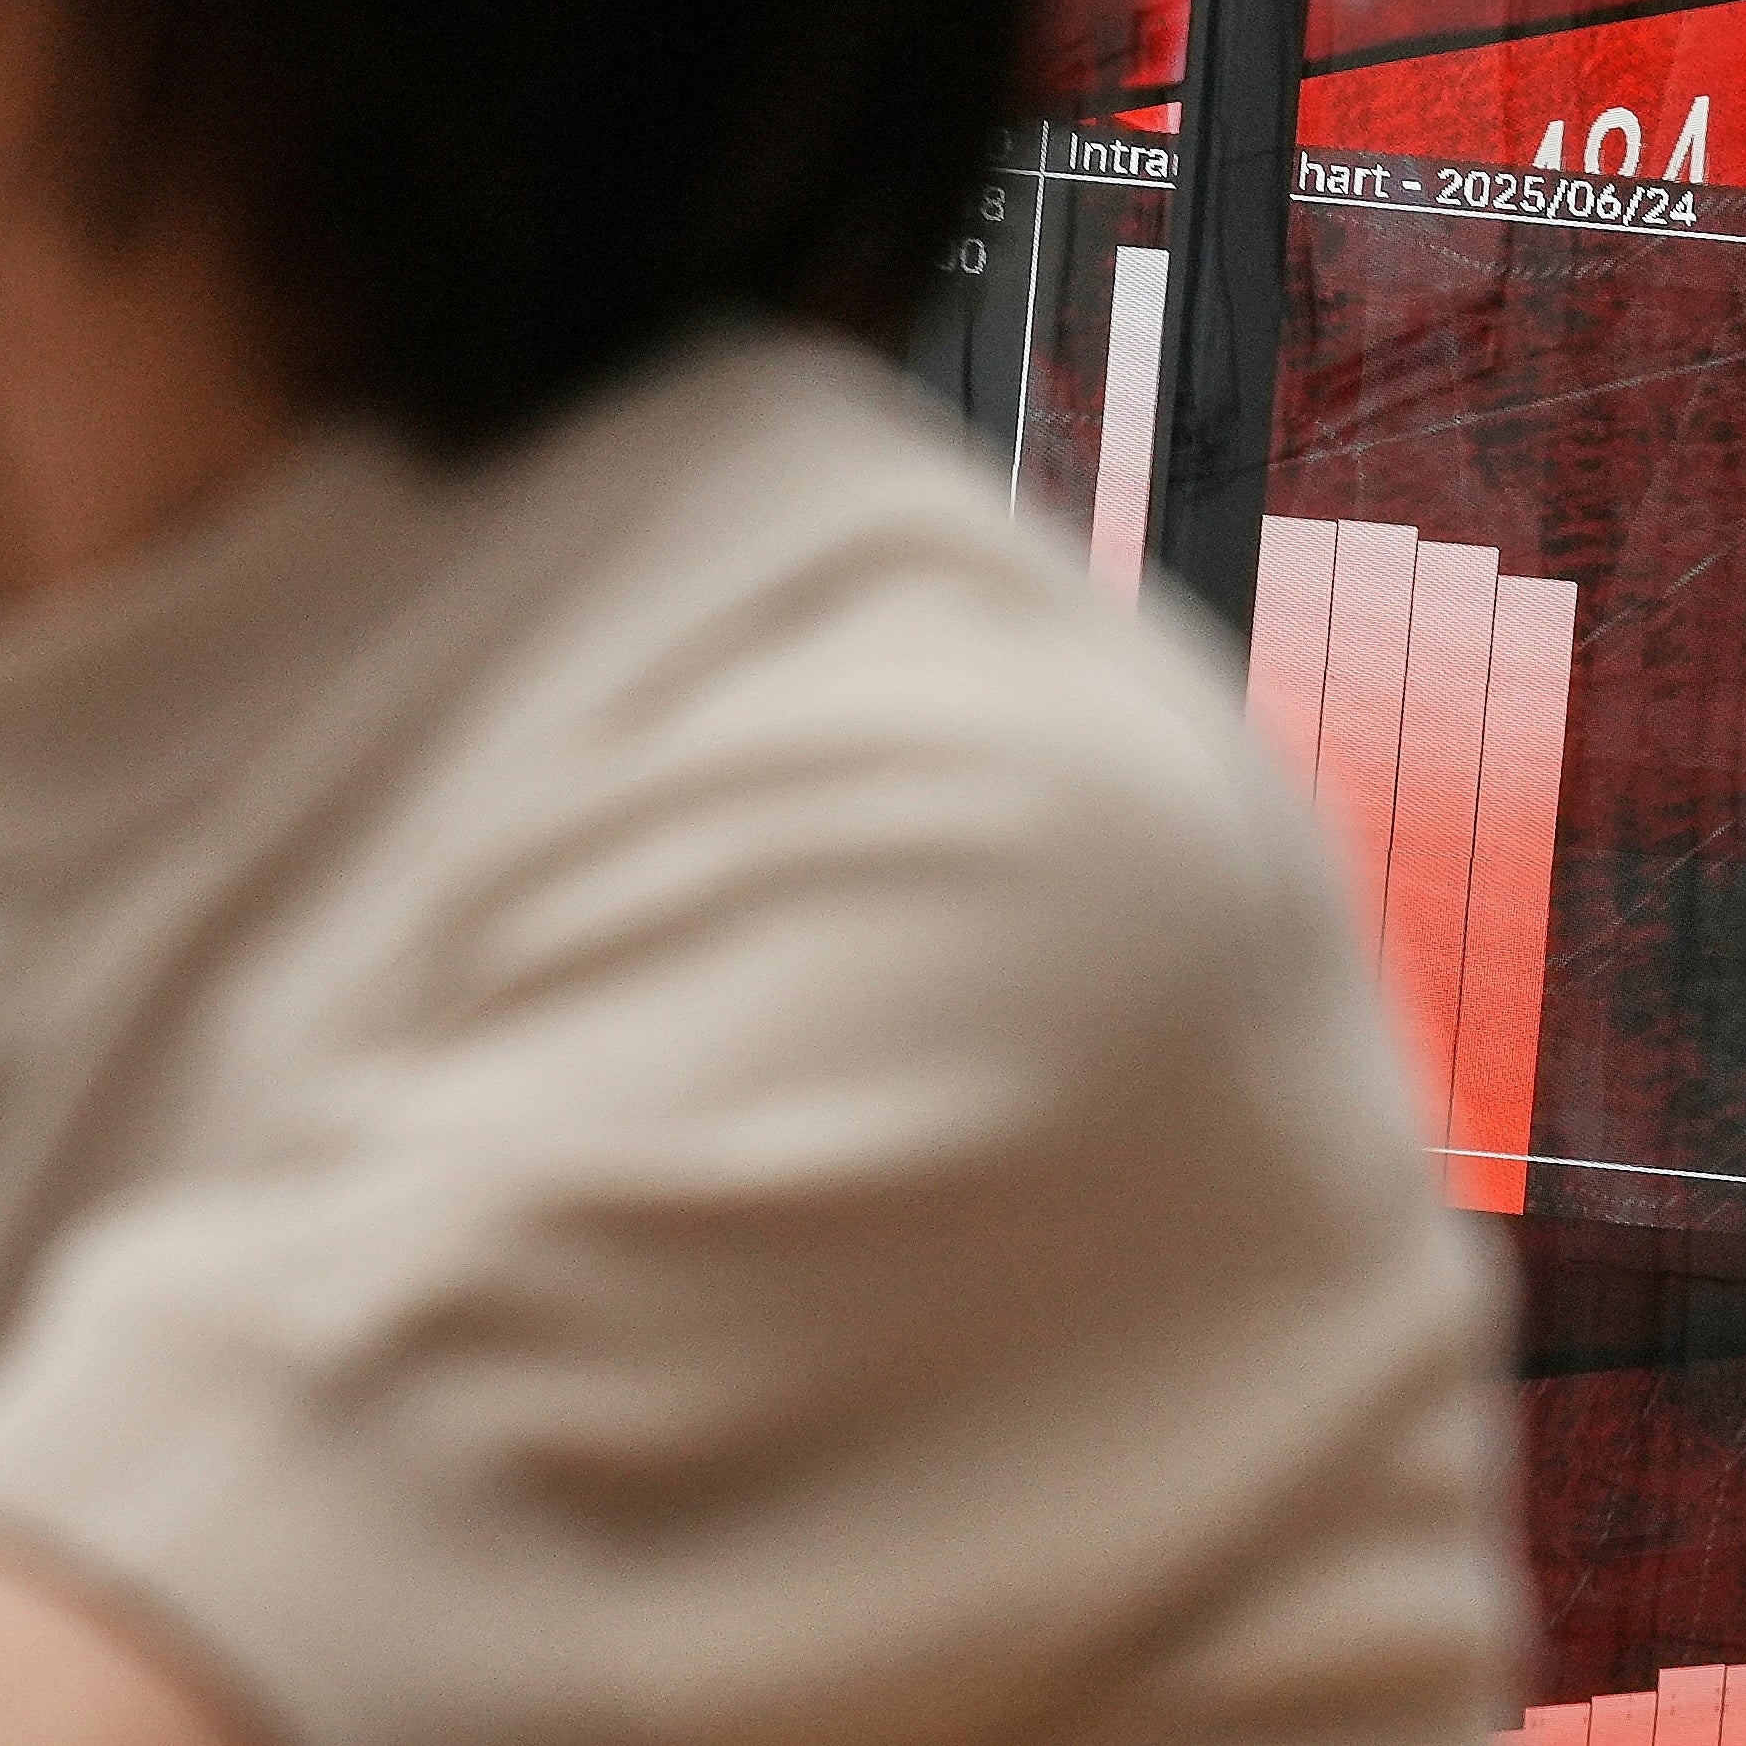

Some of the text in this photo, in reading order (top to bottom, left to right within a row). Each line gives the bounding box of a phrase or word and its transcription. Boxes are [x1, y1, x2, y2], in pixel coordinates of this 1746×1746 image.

[1069, 132, 1178, 178] Intra
[1299, 151, 1392, 198] hart
[1435, 168, 1697, 227] 2025/06/24
